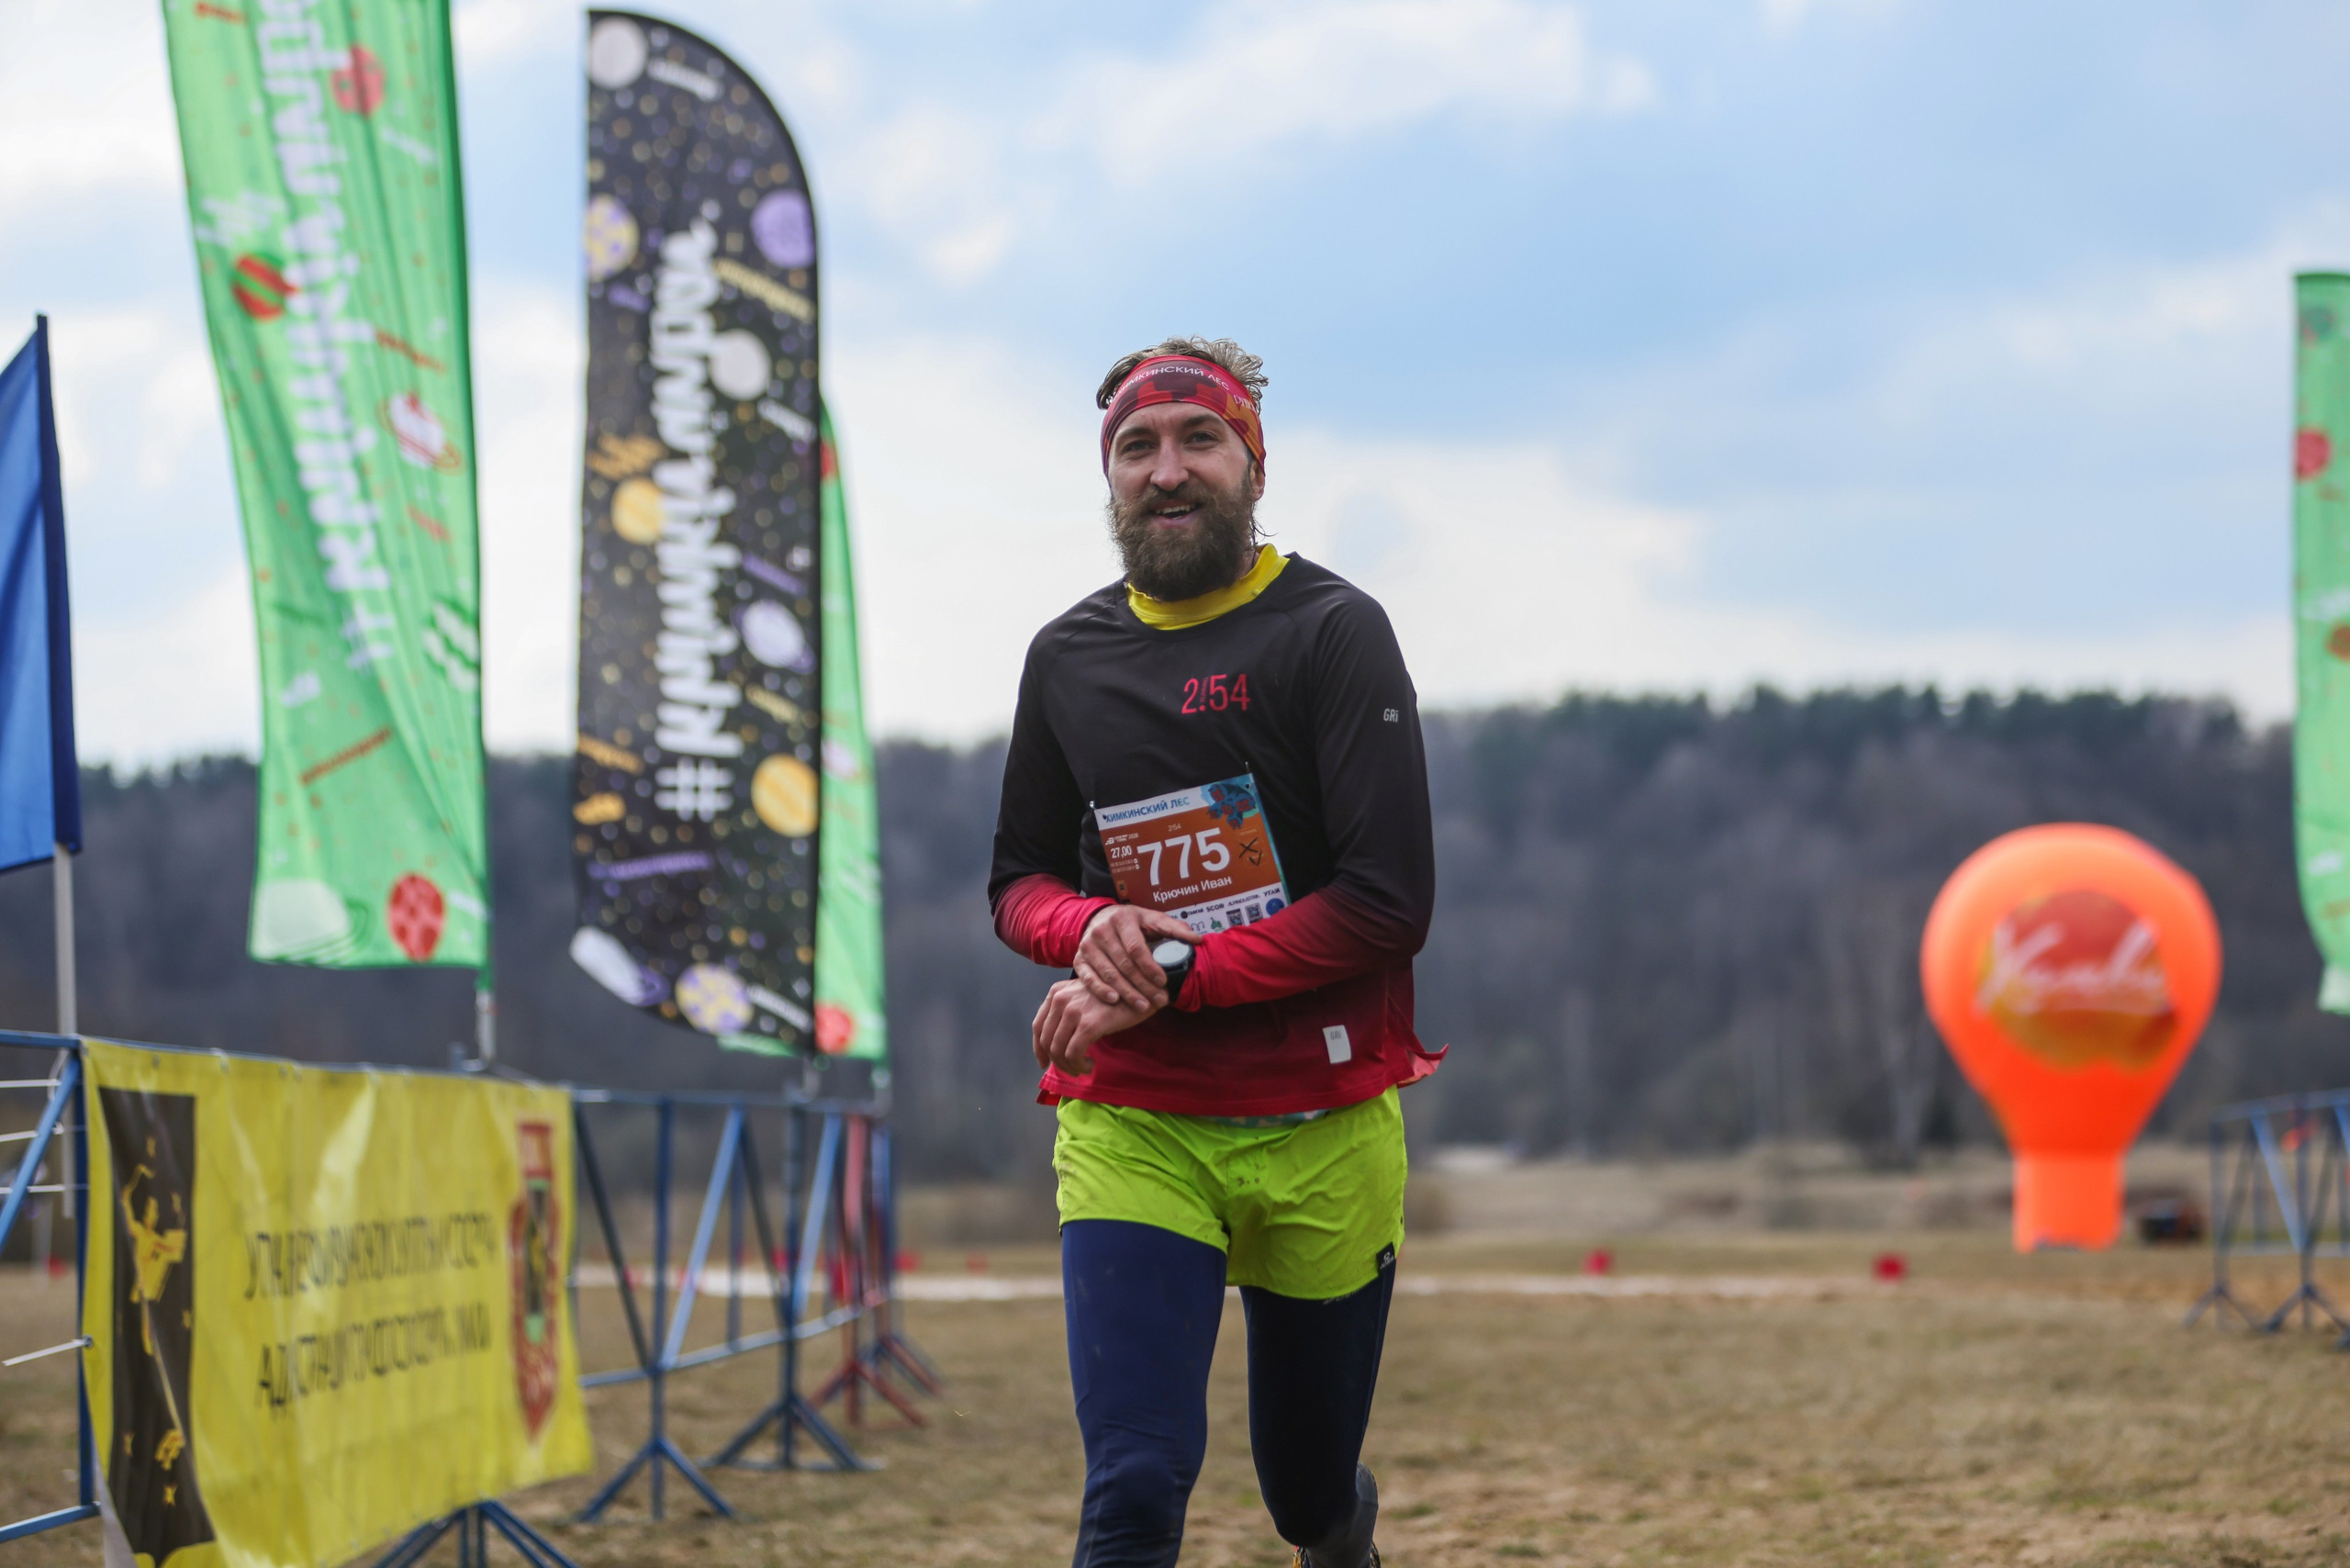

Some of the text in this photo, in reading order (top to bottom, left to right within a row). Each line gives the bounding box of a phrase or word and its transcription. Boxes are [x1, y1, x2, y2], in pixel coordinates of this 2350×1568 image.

[1207, 374, 1230, 391] ЛЕС
[1105, 797, 1191, 823] ХИМКИНСКИЙ ЛЕС
[1111, 845, 1133, 859] 27,00
[1136, 827, 1231, 887] 775
[1152, 875, 1233, 903] Крючин Иван
